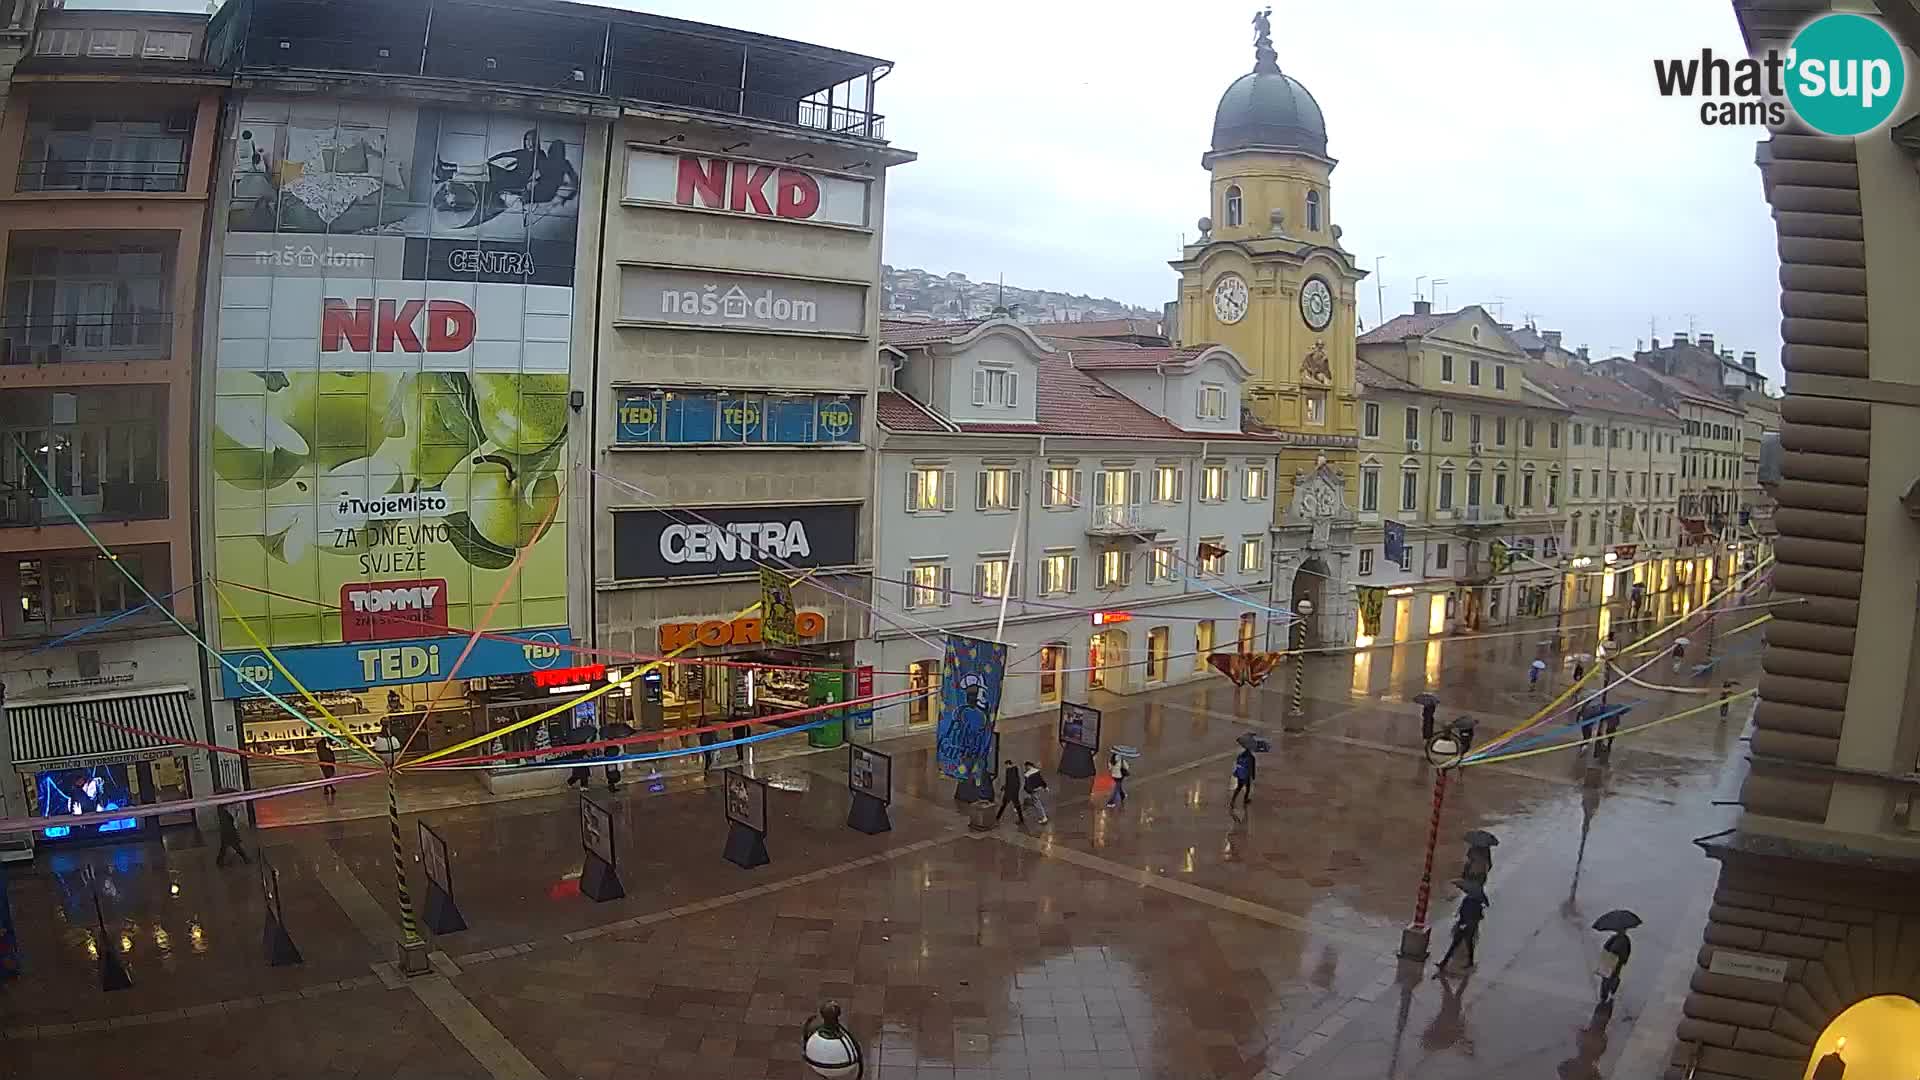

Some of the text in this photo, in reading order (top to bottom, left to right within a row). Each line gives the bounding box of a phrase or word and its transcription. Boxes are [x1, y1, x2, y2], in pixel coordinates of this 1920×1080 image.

[676, 156, 821, 220] NKD
[324, 247, 366, 267] dom
[449, 249, 535, 275] CENTRA
[661, 284, 817, 323] naš dom
[320, 297, 477, 353] NKD
[619, 407, 657, 424] TEDi
[724, 408, 760, 425] TEDi
[820, 411, 853, 427] TEDi
[338, 496, 446, 516] #TvojeMisto
[334, 523, 450, 548] ZA DNEVNO
[660, 520, 810, 564] CENTRA
[359, 547, 426, 575] SVJEŽE
[348, 586, 439, 613] TOMMY
[659, 611, 826, 652] KORO
[358, 644, 441, 682] TEDi
[522, 640, 560, 660] TEDi
[236, 665, 274, 683] TEDi
